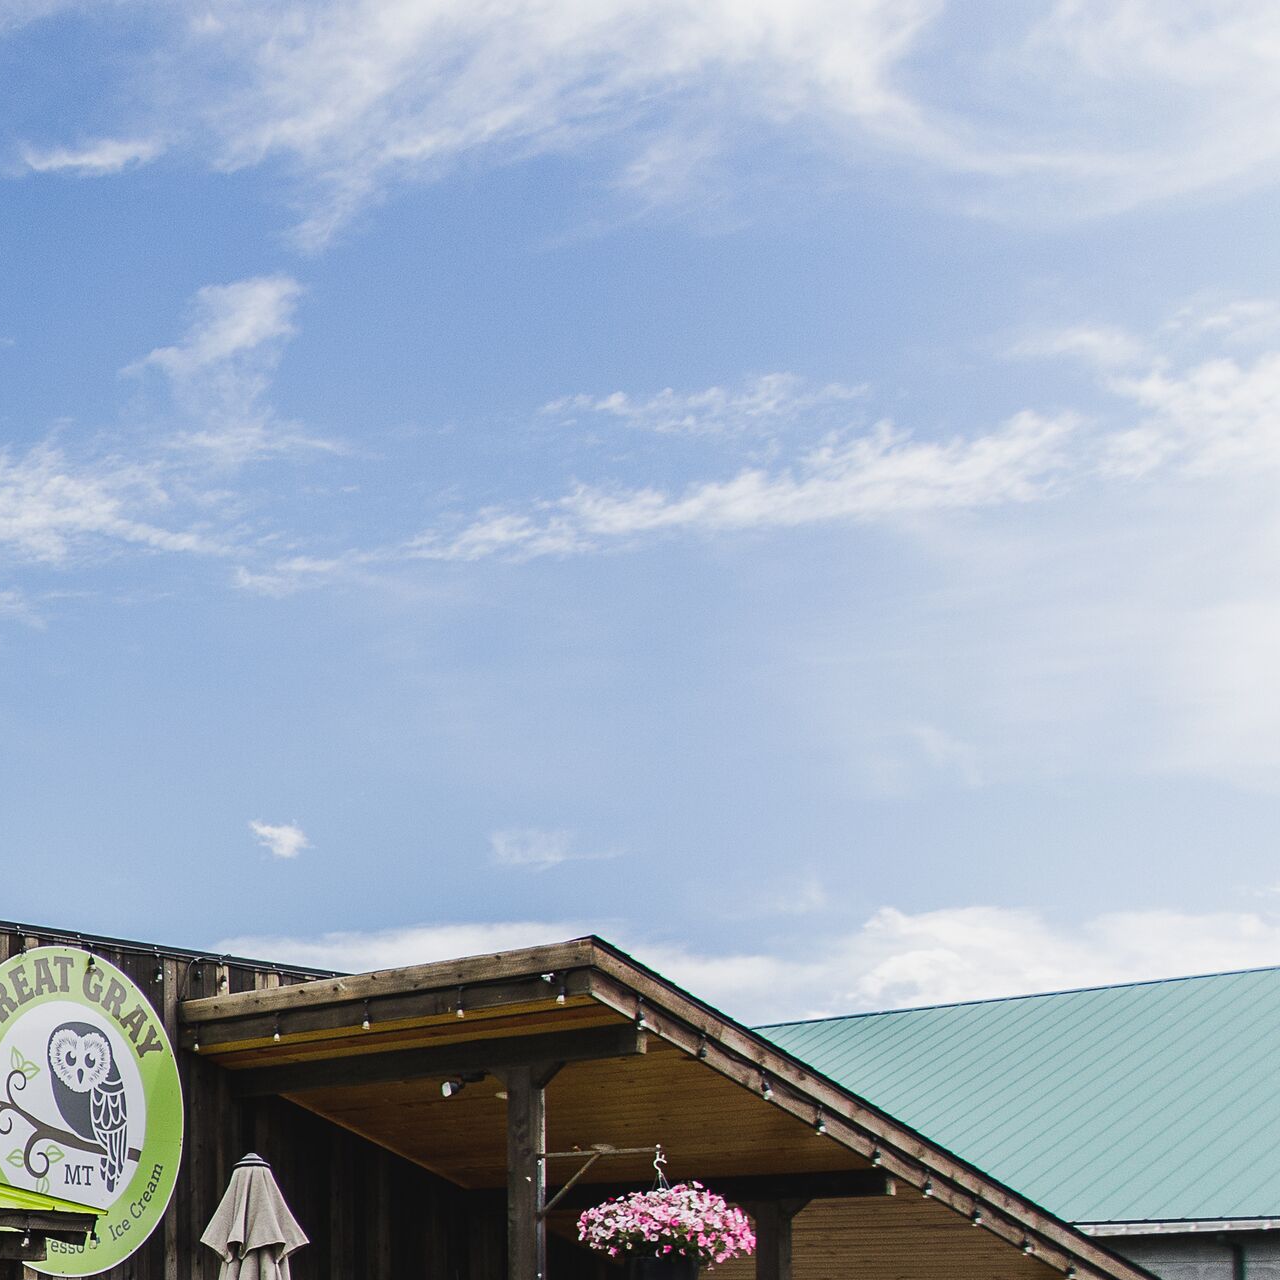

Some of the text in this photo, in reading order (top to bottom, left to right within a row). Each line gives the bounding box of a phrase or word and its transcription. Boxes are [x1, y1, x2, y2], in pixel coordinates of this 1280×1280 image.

[82, 964, 163, 1058] GRAY
[48, 1239, 85, 1254] esso
[108, 1218, 131, 1241] Ice
[130, 1163, 163, 1219] Cream
[64, 1164, 94, 1186] MT
